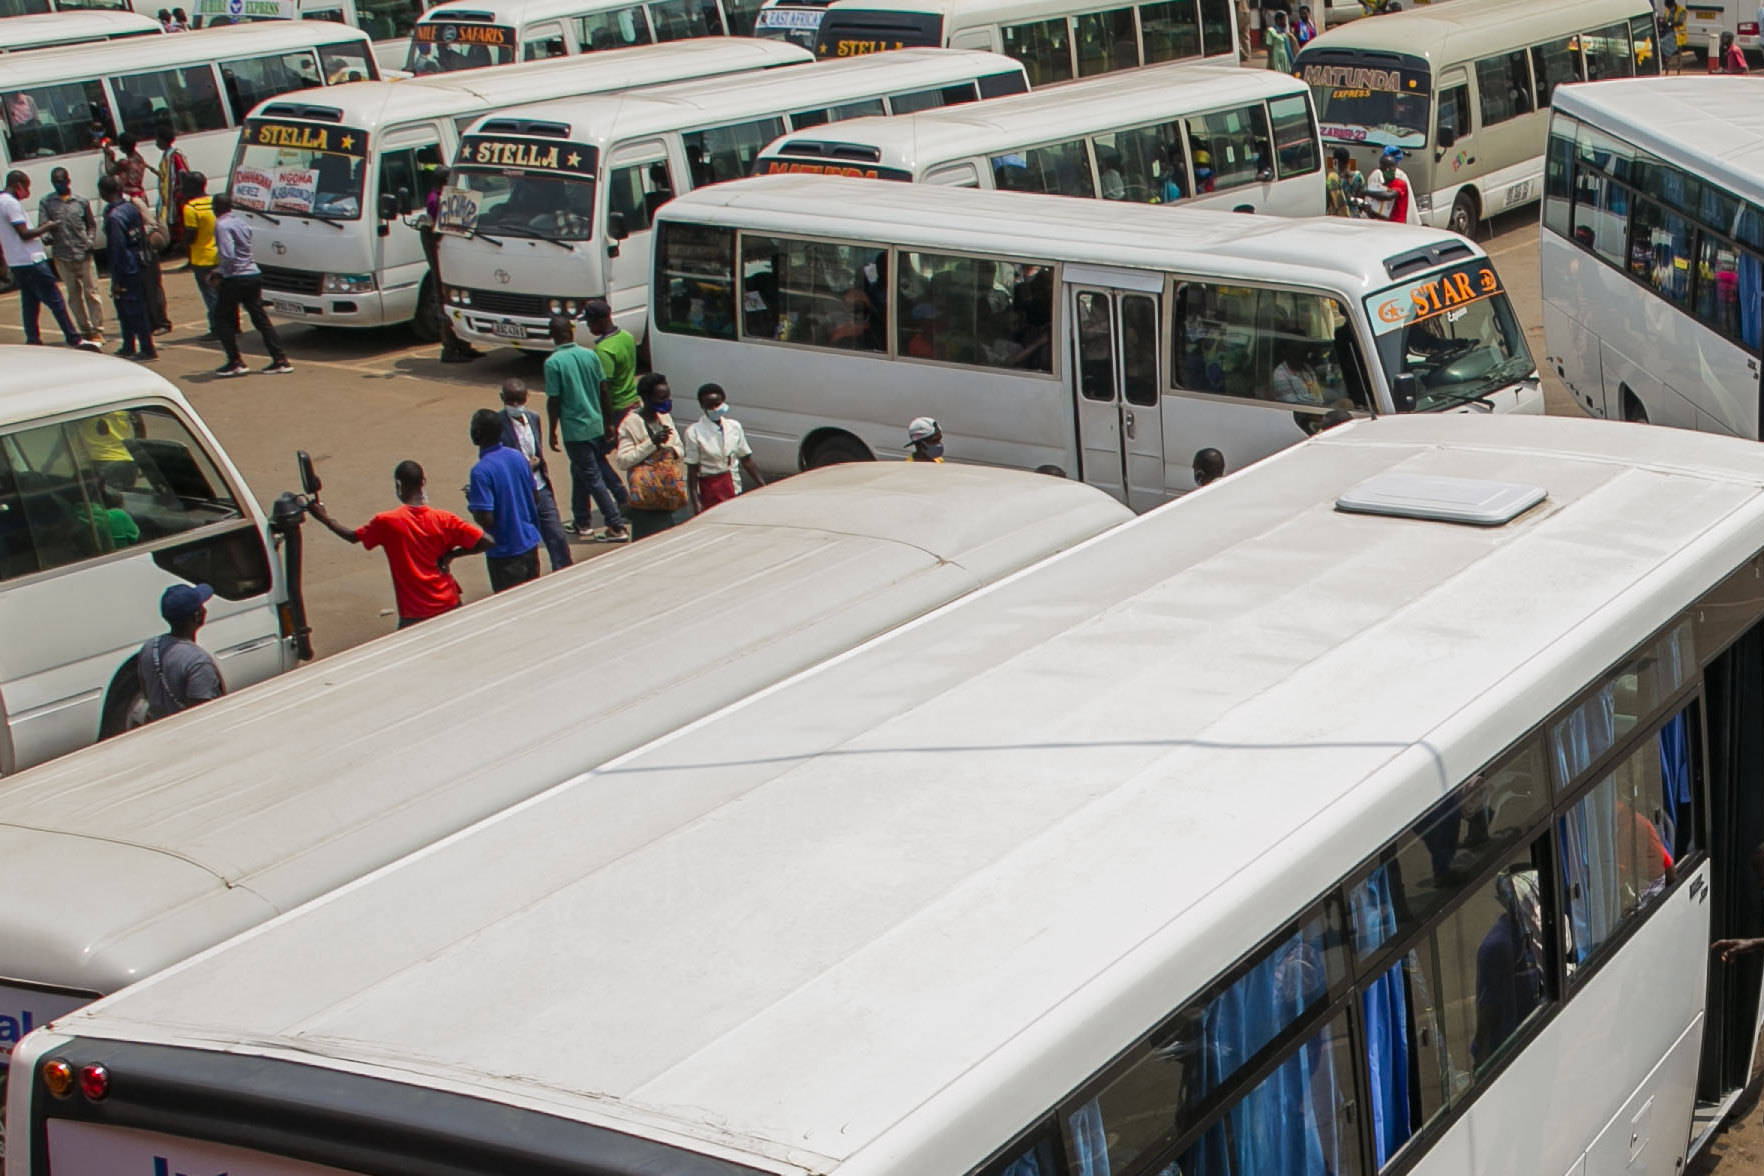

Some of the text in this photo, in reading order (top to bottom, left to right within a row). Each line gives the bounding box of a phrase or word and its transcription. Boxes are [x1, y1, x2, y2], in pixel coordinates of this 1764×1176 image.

[1303, 65, 1401, 92] MATUNDA
[258, 125, 329, 150] STELLA
[475, 141, 560, 169] STELLA
[1409, 271, 1477, 317] STAR
